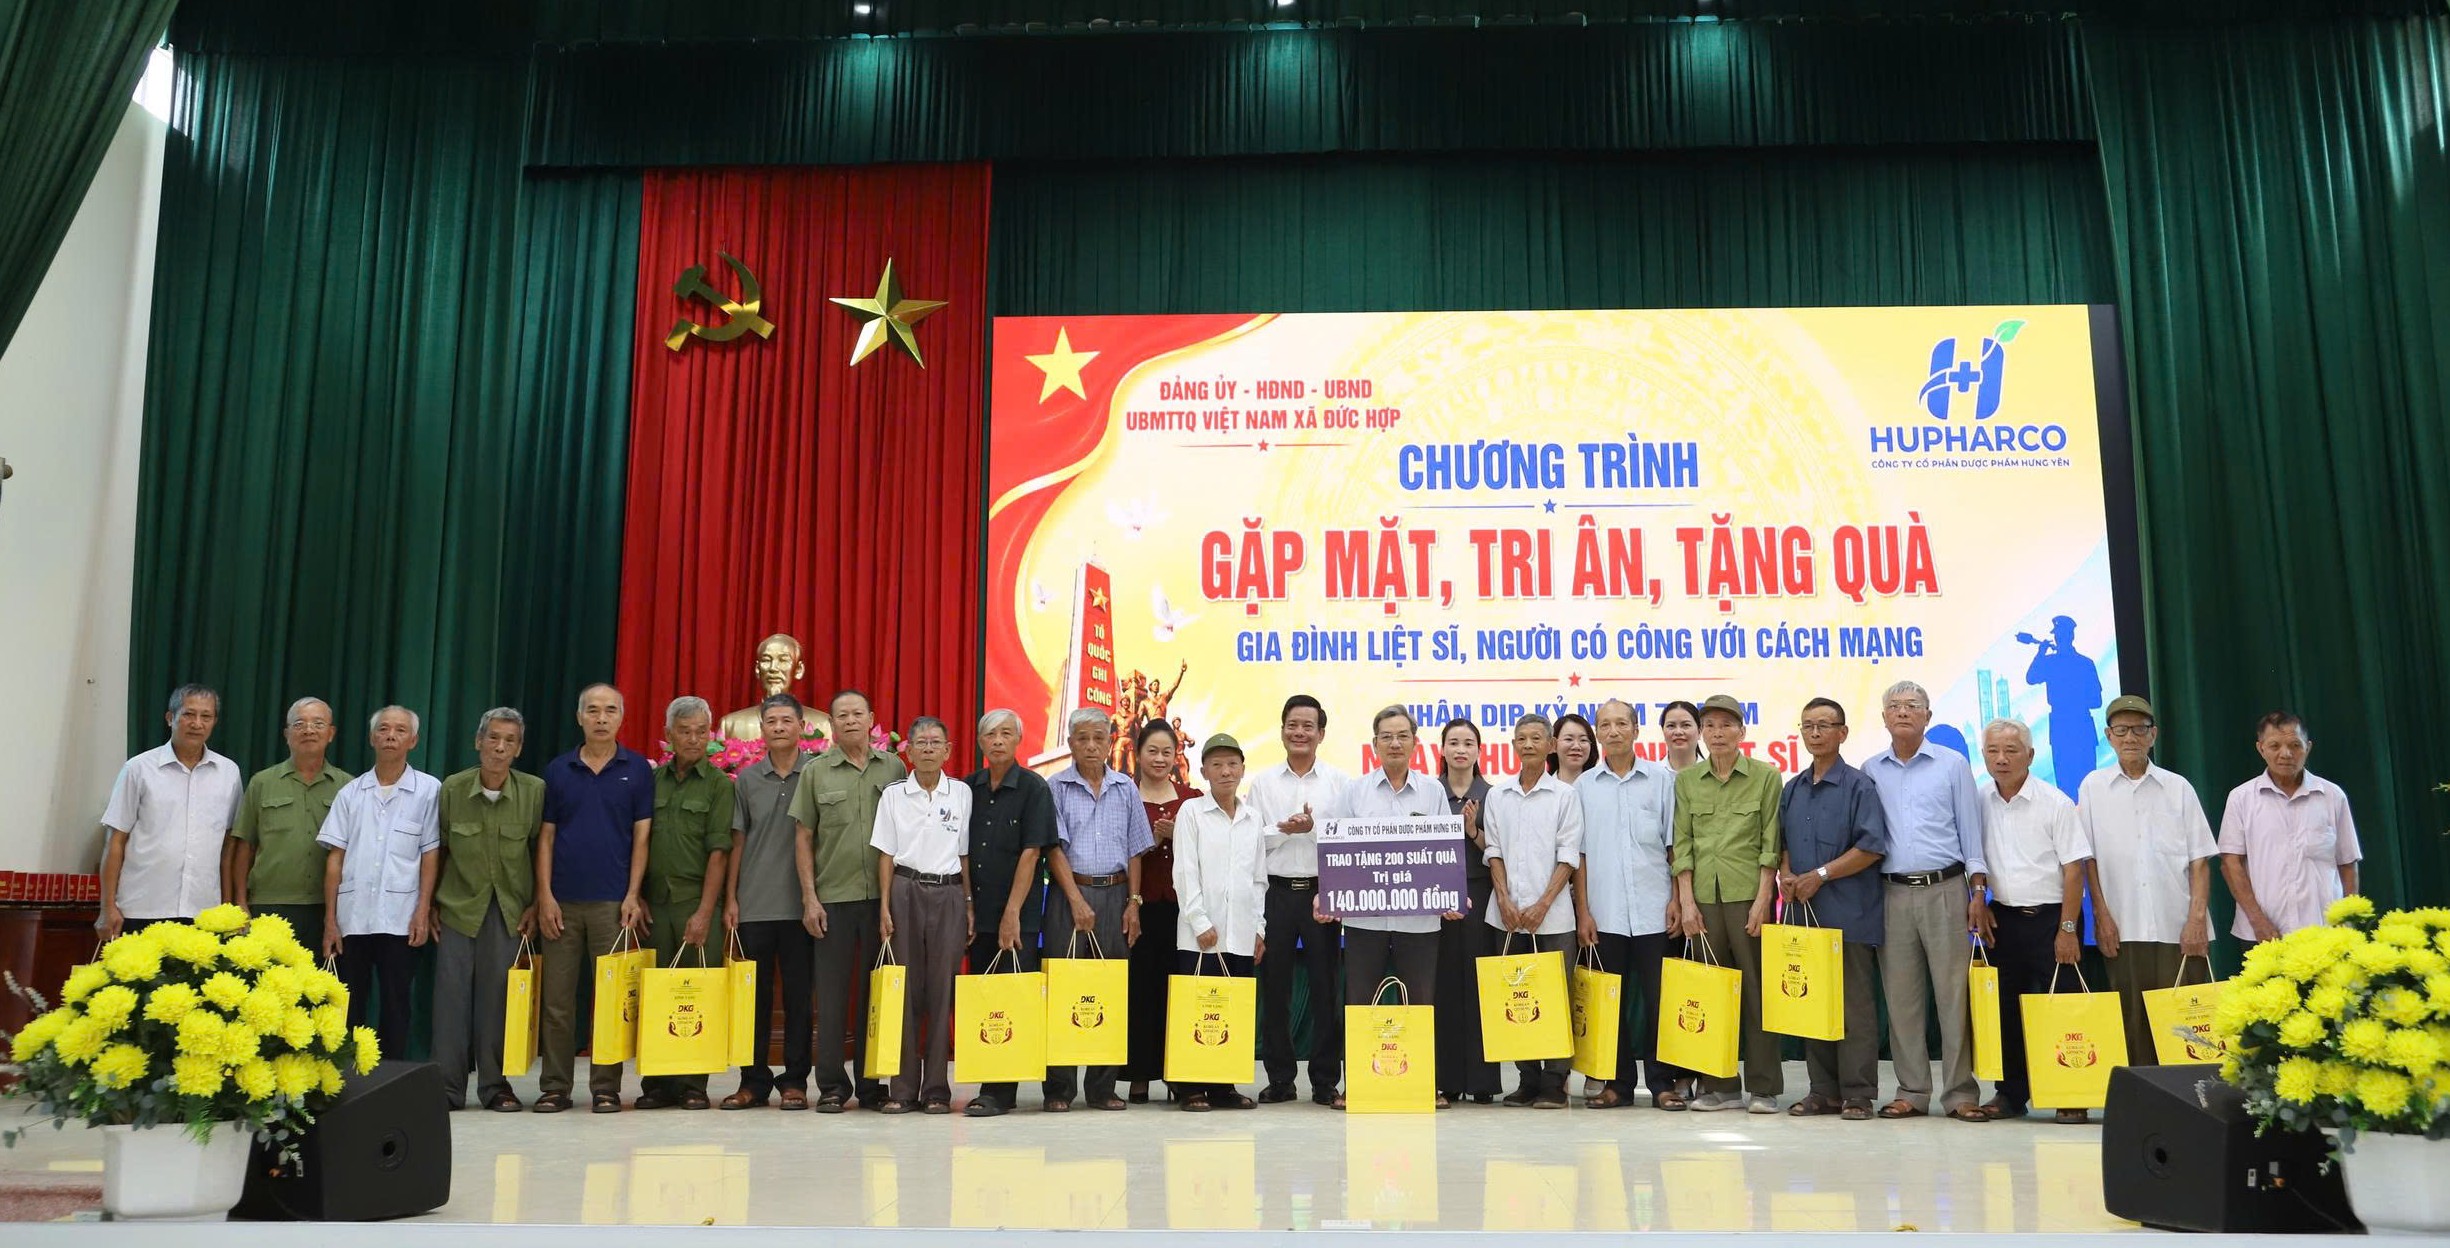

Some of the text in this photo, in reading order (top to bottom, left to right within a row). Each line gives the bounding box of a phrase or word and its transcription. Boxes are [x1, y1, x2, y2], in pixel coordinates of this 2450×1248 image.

[1159, 375, 1208, 400] ĐẢNG
[1215, 374, 1237, 400] ỦY
[1256, 380, 1305, 399] HĐND
[1324, 379, 1372, 399] UBND
[1126, 404, 1401, 434] UBMTTQ VIỆT NAM XÃ ĐỨC HỢP
[1870, 425, 2067, 453] HUPHARCO
[1399, 432, 1699, 490] CHƯƠNG TRÌNH
[1871, 458, 1899, 469] CÔNG
[1902, 460, 1912, 469] TY
[1961, 459, 1989, 469] DƯỢC
[2021, 458, 2049, 467] HƯNG
[2051, 458, 2070, 468] YÊN
[1201, 511, 1940, 615] GẶP MẶT, TRI ÂN, TẶNG QUÀ
[1237, 621, 1923, 668] GIA ĐÌNH LIỆT SĨ, NGƯỜI CÓ CÔNG VỚI CÁCH MẠNG
[1092, 665, 1108, 682] GHI
[1409, 699, 1471, 727] HÂN
[1481, 704, 1525, 732] DỊP
[1768, 734, 1799, 773] SĨ
[1348, 825, 1364, 836] CÔNG
[1365, 826, 1373, 835] TY
[1326, 847, 1457, 869] TRAO TẶNG 200 SUẤT QUÀ
[1373, 870, 1413, 886] Trị giá
[1328, 884, 1460, 912] 140.000.000 đồng
[1080, 995, 1096, 1003] DKG
[1513, 991, 1529, 999] DKG
[678, 1004, 694, 1012] DKG
[1204, 1013, 1220, 1021] DKG
[2192, 1024, 2210, 1033] DKG
